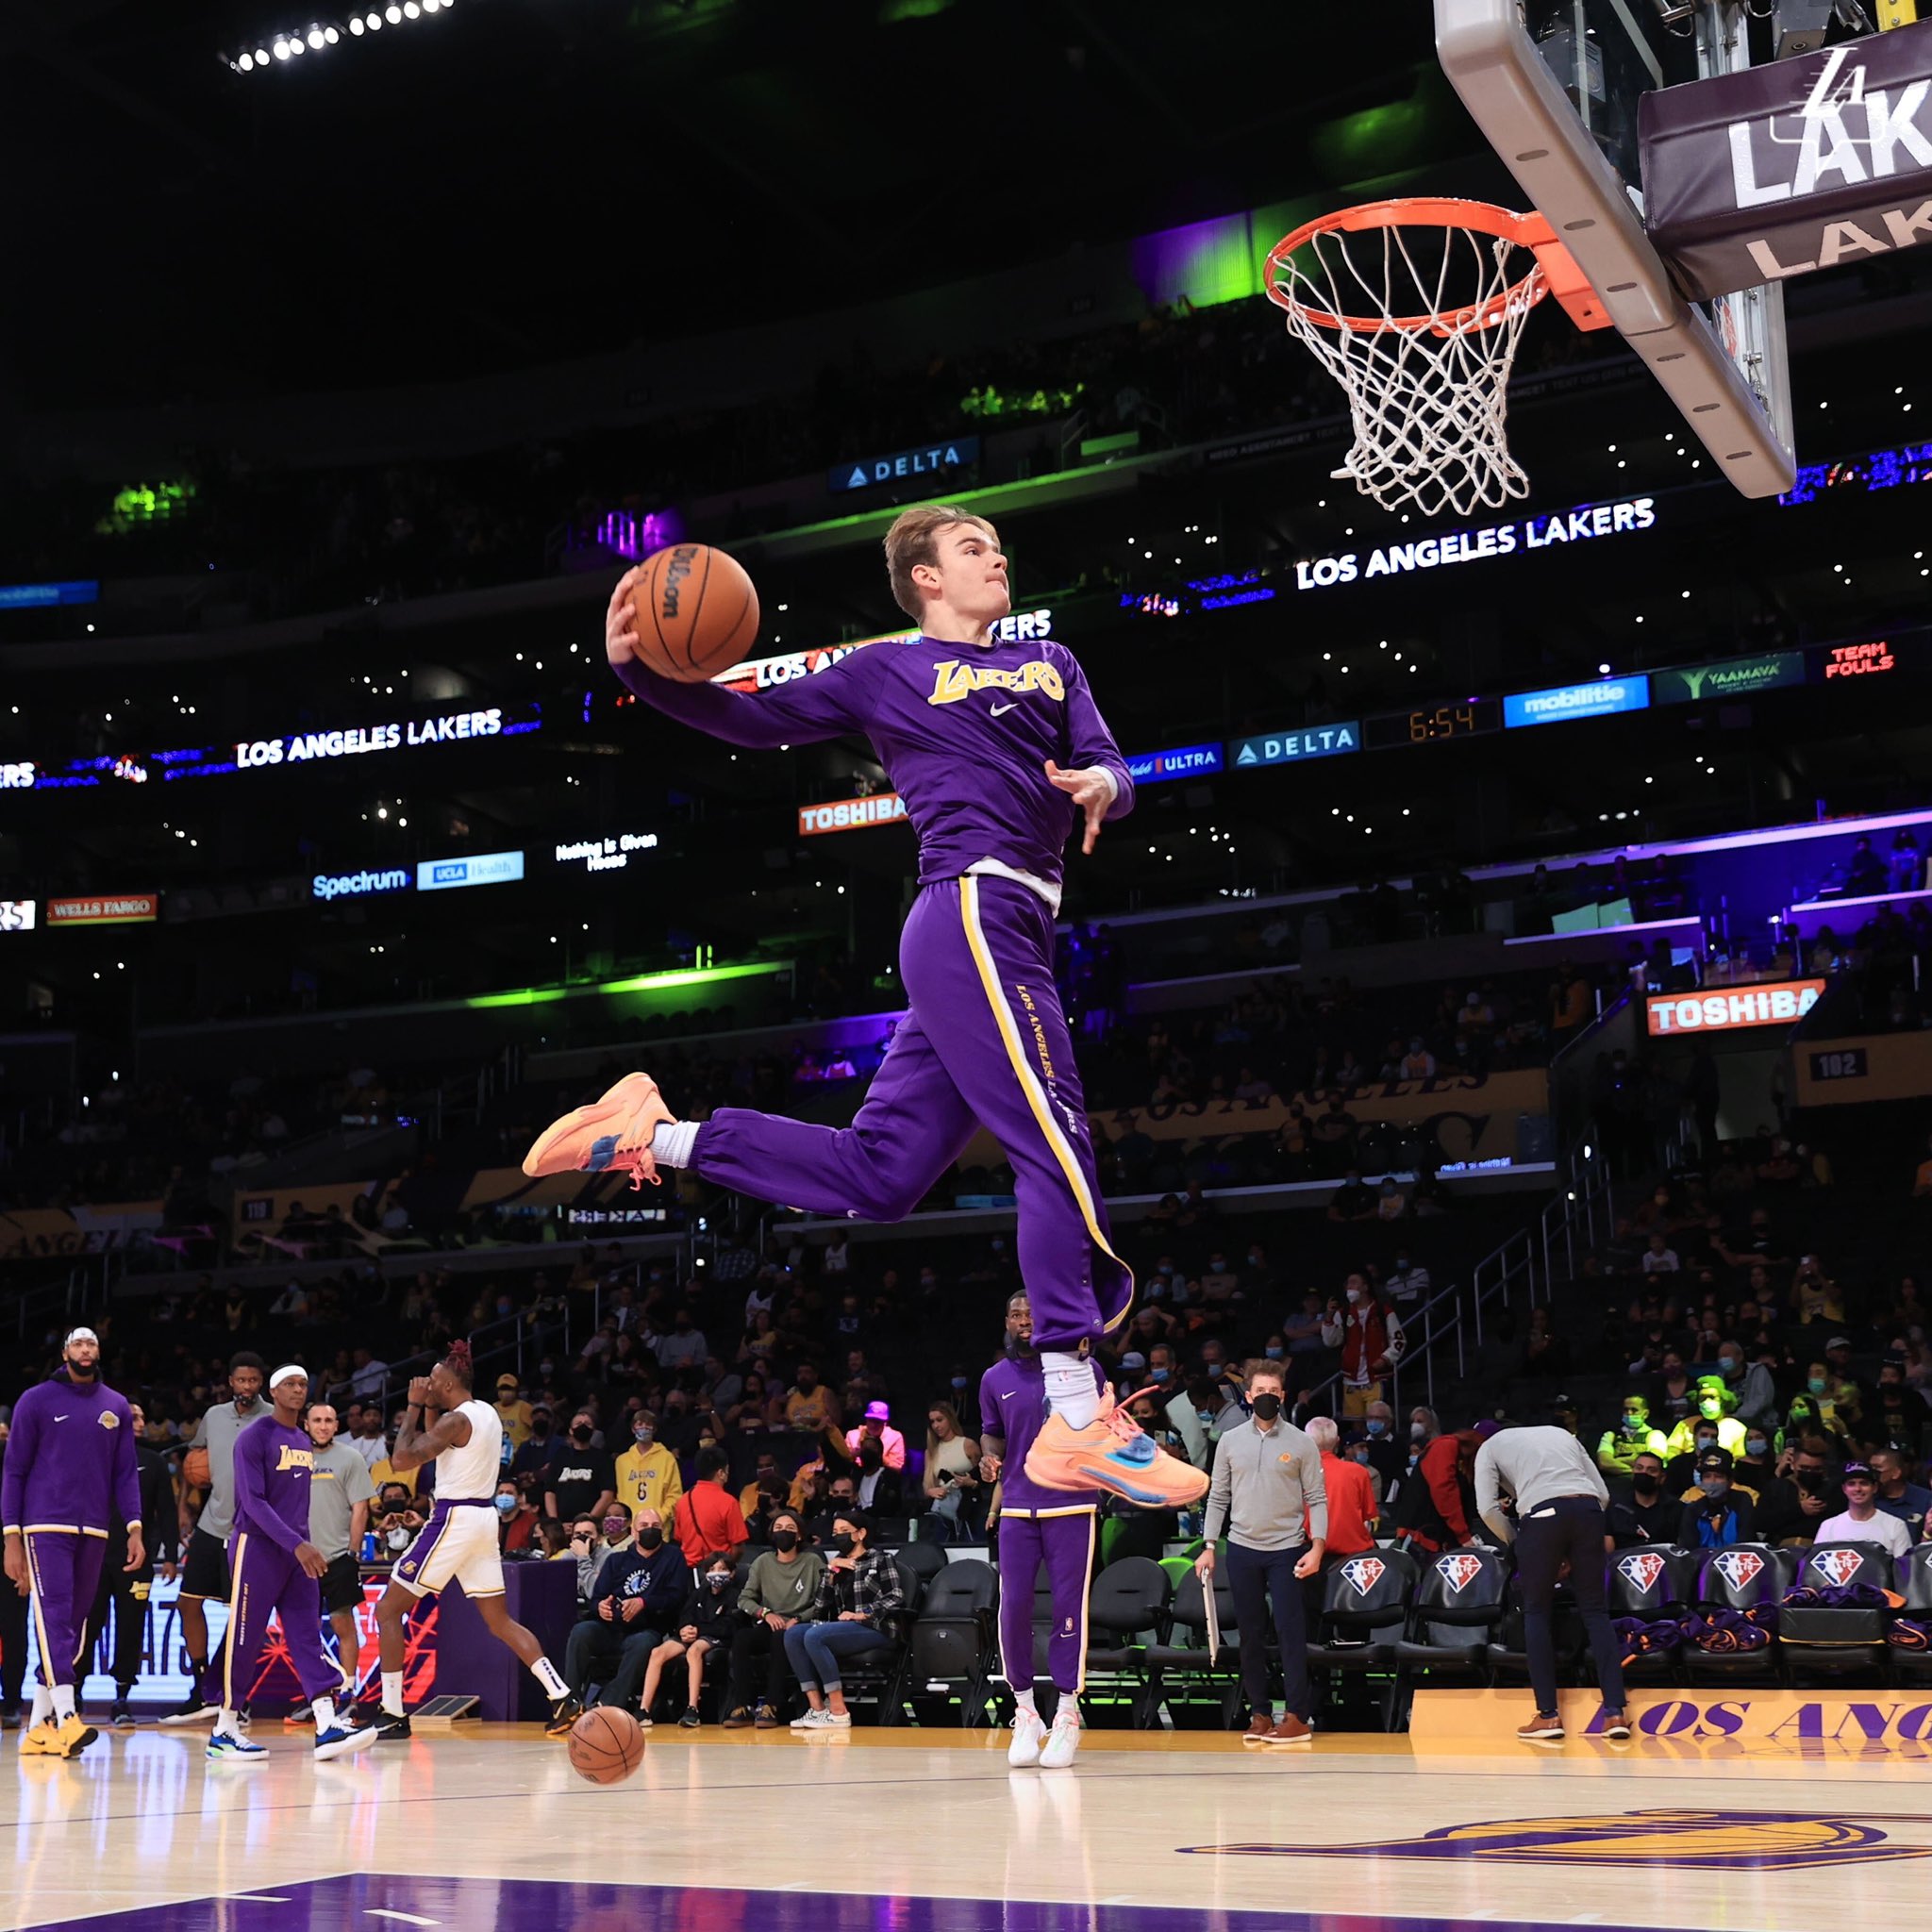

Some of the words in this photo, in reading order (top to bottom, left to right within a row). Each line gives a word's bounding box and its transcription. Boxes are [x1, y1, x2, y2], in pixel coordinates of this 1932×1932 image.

[875, 446, 960, 481] DELTA
[1297, 554, 1357, 590] LOS
[1365, 526, 1516, 577] ANGELES
[1525, 498, 1655, 549] LAKERS
[987, 609, 1051, 641] ERS
[1825, 655, 1894, 679] FOULS
[1831, 641, 1887, 662] TEAM
[756, 653, 807, 689] LOS
[927, 659, 1065, 706] LAKERS
[1524, 685, 1625, 714] mobilitie
[237, 739, 283, 769] LOS
[287, 724, 401, 762] ANGELES
[407, 708, 502, 745] LAKERS
[1410, 707, 1474, 741] 6:54
[1264, 728, 1354, 759] DELTA
[1164, 751, 1217, 772] ULTRA
[801, 796, 908, 831] TOSHIBA
[313, 870, 407, 901] Spectrum
[436, 867, 466, 881] UCLA
[54, 902, 101, 918] WELLS
[104, 899, 151, 915] FARGO
[1651, 987, 1819, 1030] TOSHIBA
[1015, 983, 1036, 1011] LOS
[1027, 1012, 1057, 1079] ANGELES
[637, 1481, 648, 1503] 6
